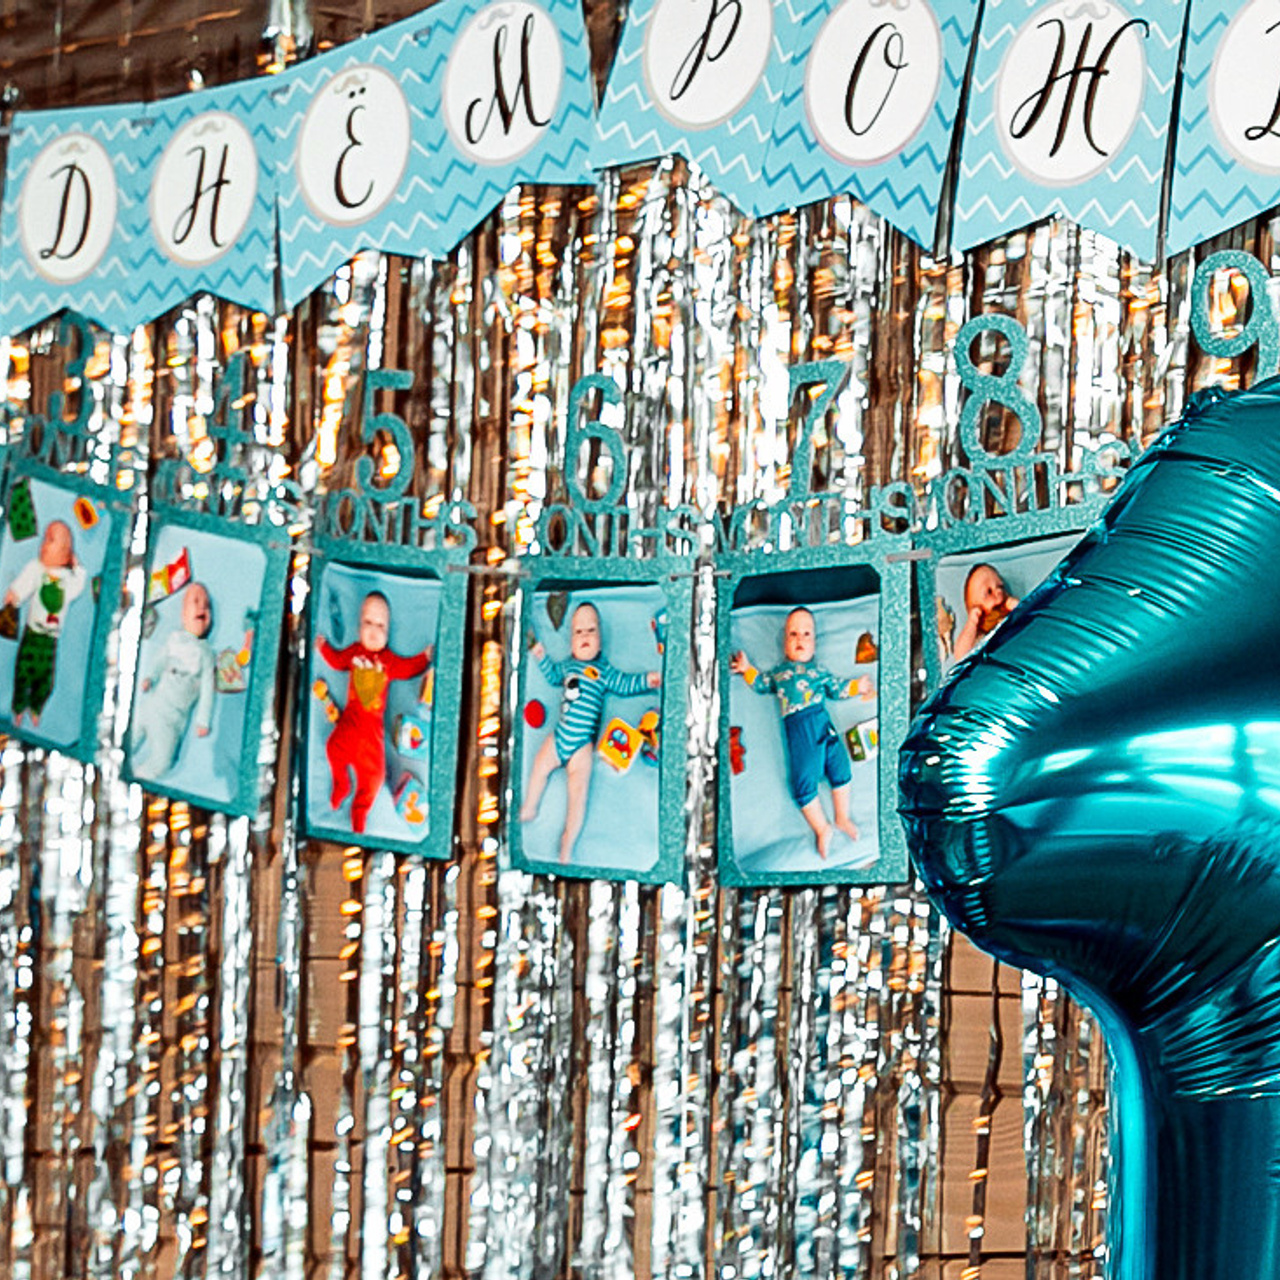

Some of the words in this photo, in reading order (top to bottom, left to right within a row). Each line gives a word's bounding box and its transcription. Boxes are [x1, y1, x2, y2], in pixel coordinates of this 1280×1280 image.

[355, 368, 415, 502] 5
[564, 371, 628, 508] 6
[787, 358, 852, 500] 7
[954, 313, 1042, 462] 8
